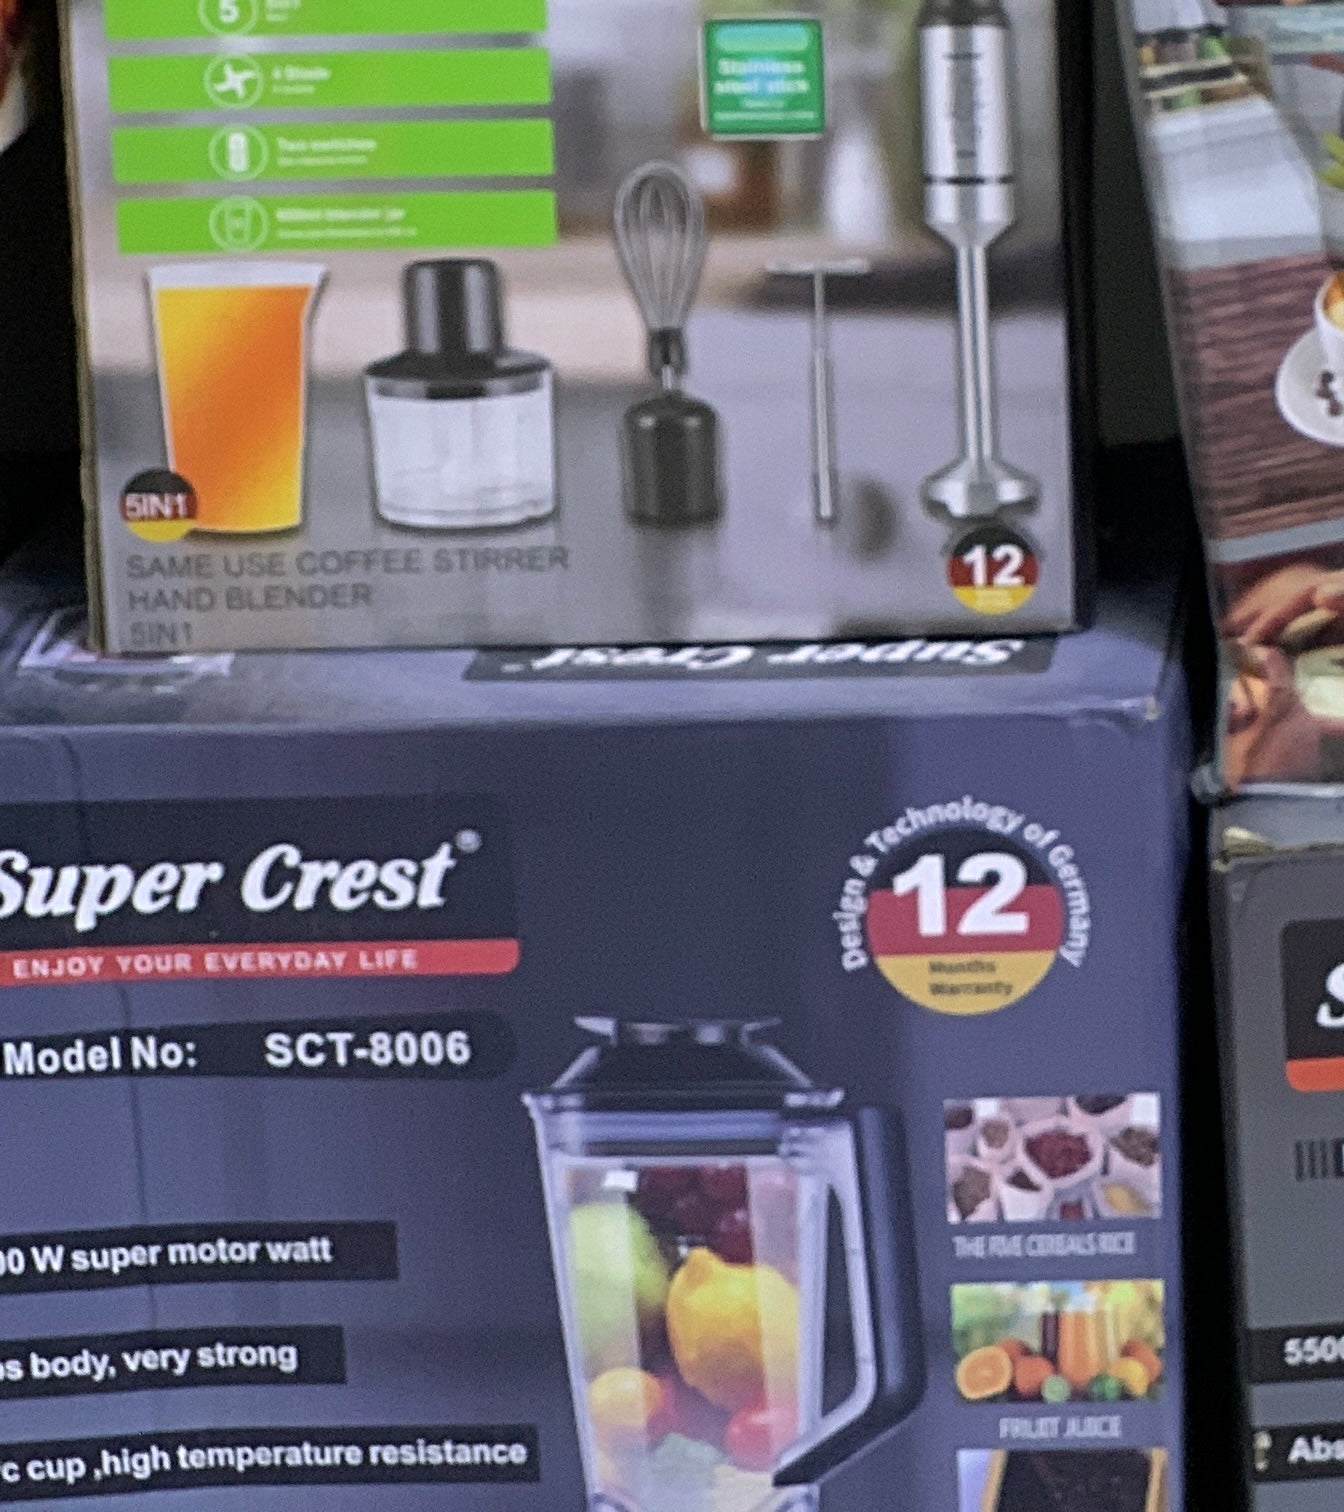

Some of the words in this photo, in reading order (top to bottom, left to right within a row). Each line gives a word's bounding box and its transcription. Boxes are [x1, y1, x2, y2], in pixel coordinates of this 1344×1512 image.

[125, 492, 189, 519] 5IN1
[127, 554, 214, 580] SAME
[223, 551, 286, 577] USE
[295, 548, 424, 576] COFFEE
[434, 545, 569, 573] STIRRER
[963, 544, 1026, 587] 12
[129, 587, 215, 613] HAND
[226, 583, 373, 610] BLENDER
[130, 620, 193, 647] 5IN1
[240, 842, 457, 912] Crest
[893, 852, 1030, 937] 12
[13, 956, 104, 979] ENJOY
[117, 952, 193, 974] YOUR
[205, 950, 346, 974] EVERYDAY
[359, 948, 419, 971] LIFE
[3, 1038, 121, 1076] Model
[132, 1035, 197, 1068] No:
[265, 1031, 471, 1068] SCT-8006
[31, 1244, 64, 1273] W
[71, 1243, 162, 1276] super
[168, 1235, 260, 1265] motor
[266, 1236, 333, 1262] watt
[30, 1348, 117, 1382] body,
[122, 1347, 191, 1377] very
[197, 1342, 299, 1373] strong
[1000, 1415, 1058, 1440] FRUIT
[1063, 1415, 1122, 1438] JUICE
[26, 1455, 86, 1485] cup
[177, 1440, 362, 1472] temperature
[369, 1438, 528, 1466] resistance
